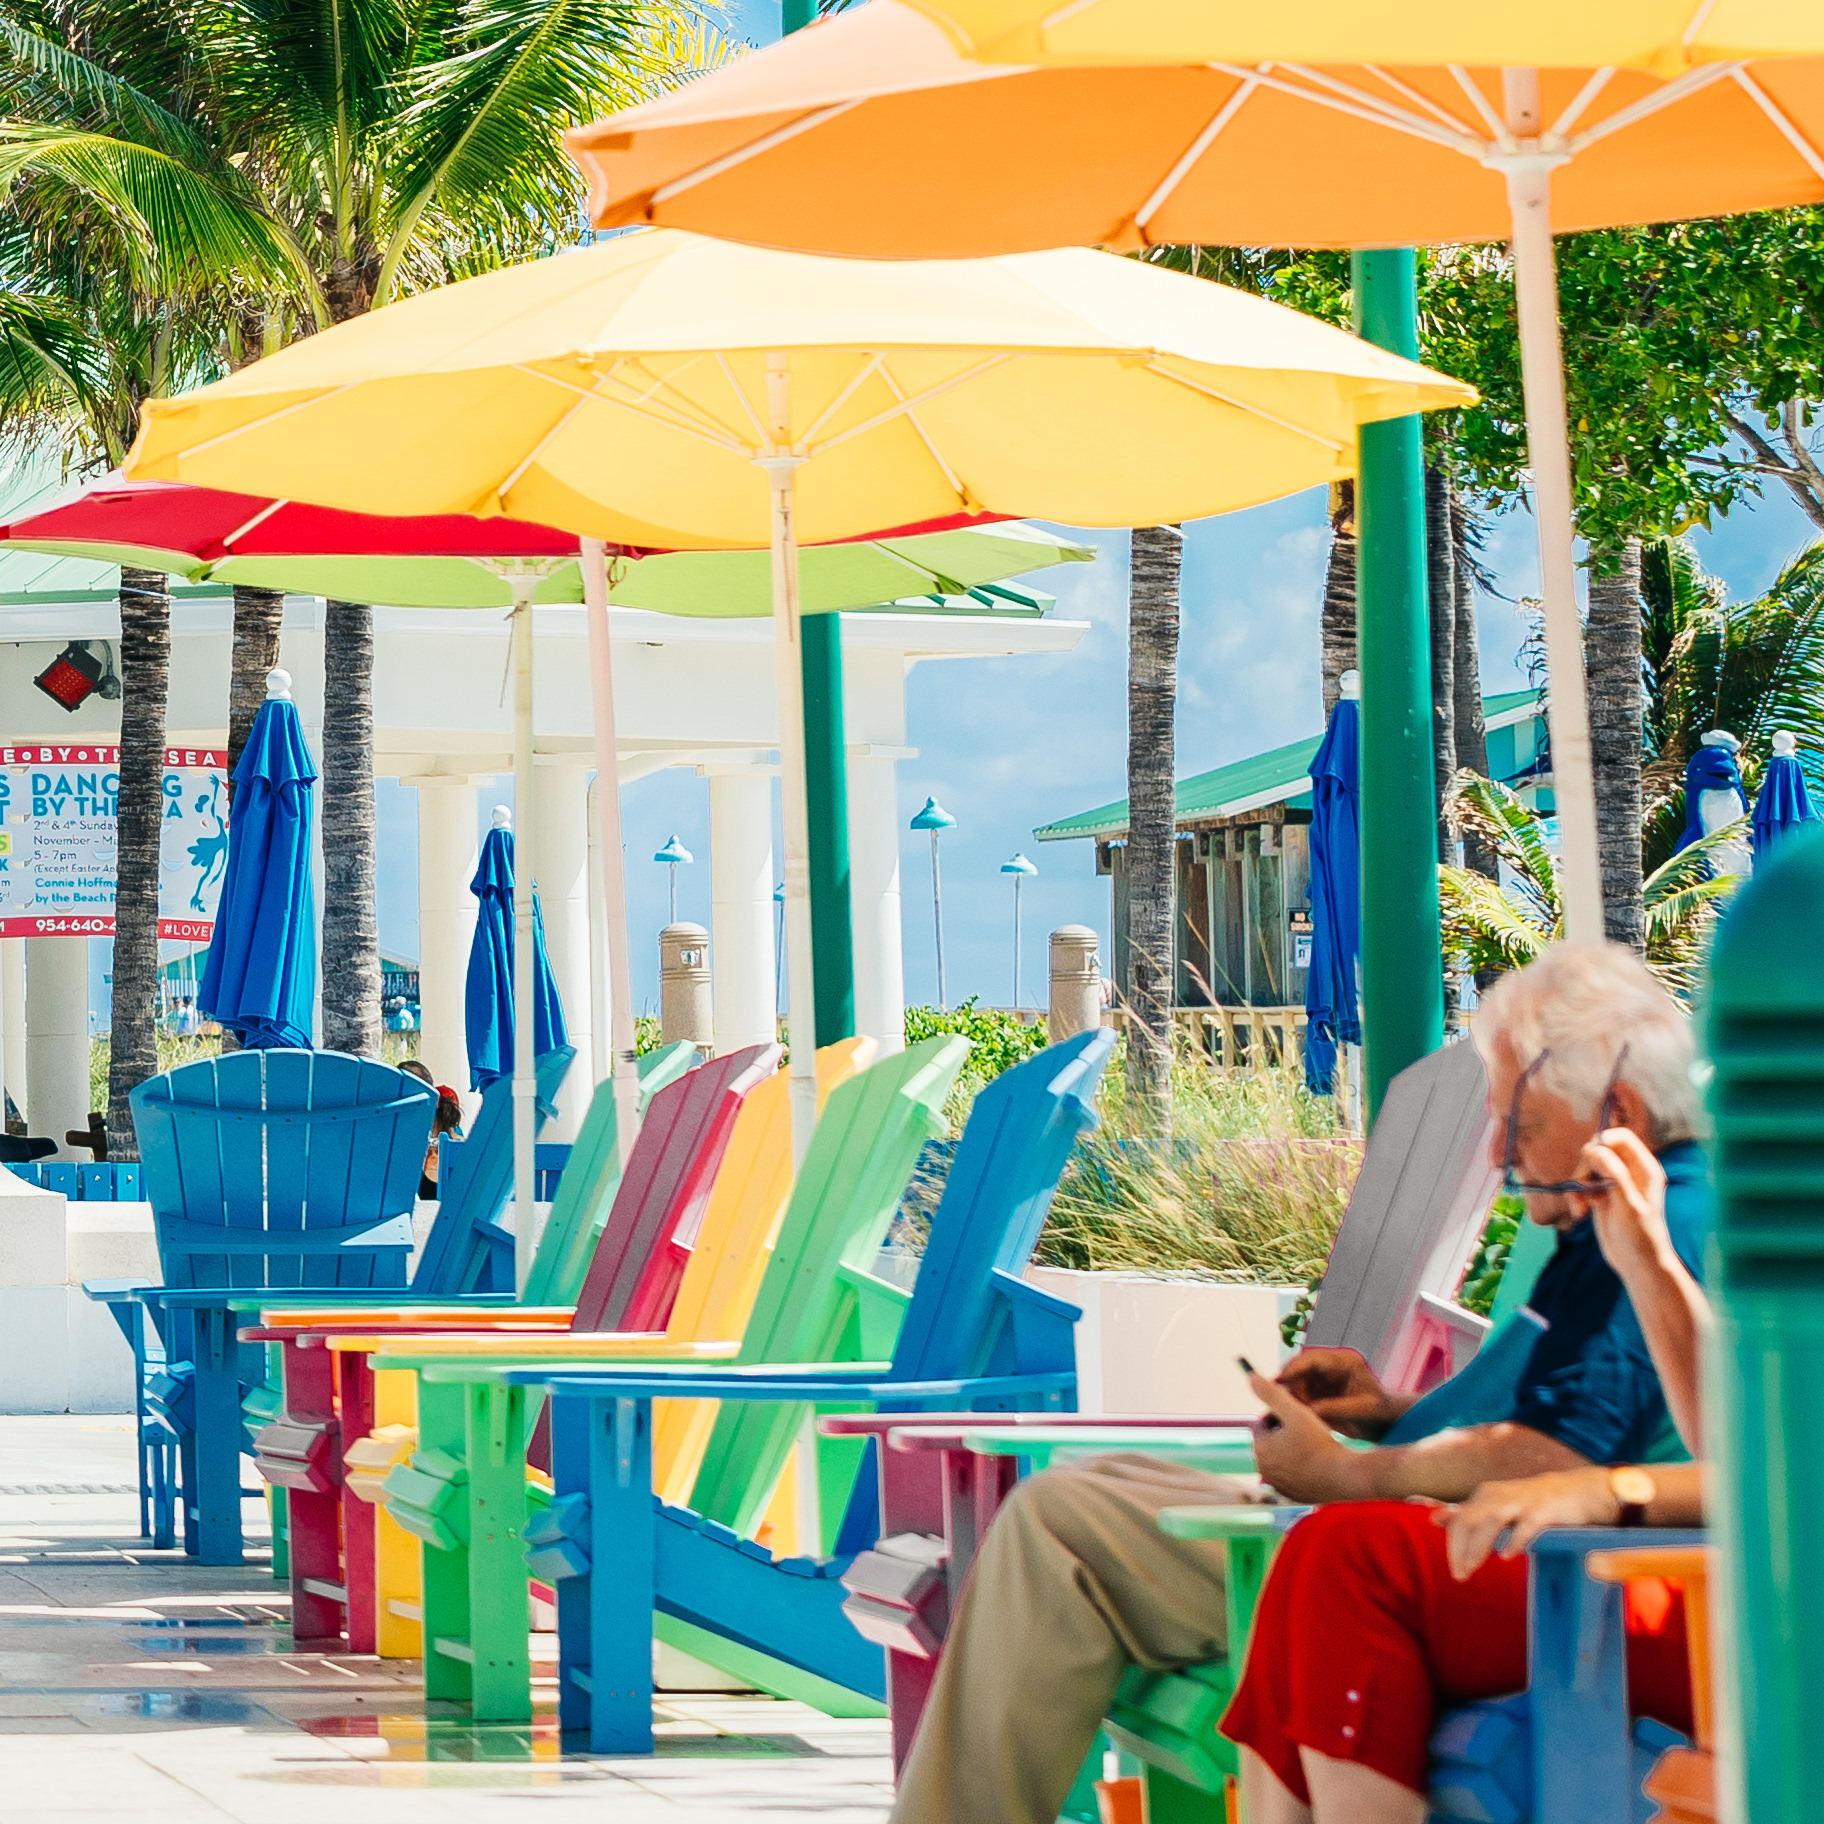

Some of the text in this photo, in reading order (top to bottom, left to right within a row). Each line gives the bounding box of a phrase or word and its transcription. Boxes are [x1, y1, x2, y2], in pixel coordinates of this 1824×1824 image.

[40, 747, 72, 762] BY
[168, 750, 216, 766] SEA
[31, 772, 183, 798] DANCG
[32, 796, 66, 817] BY
[51, 820, 61, 831] &
[33, 834, 91, 845] November
[33, 849, 41, 860] 5
[52, 849, 77, 862] 7pm
[71, 864, 101, 873] Easter
[35, 877, 75, 888] Connie
[35, 893, 49, 905] by
[51, 892, 70, 903] the
[73, 892, 107, 903] Beach
